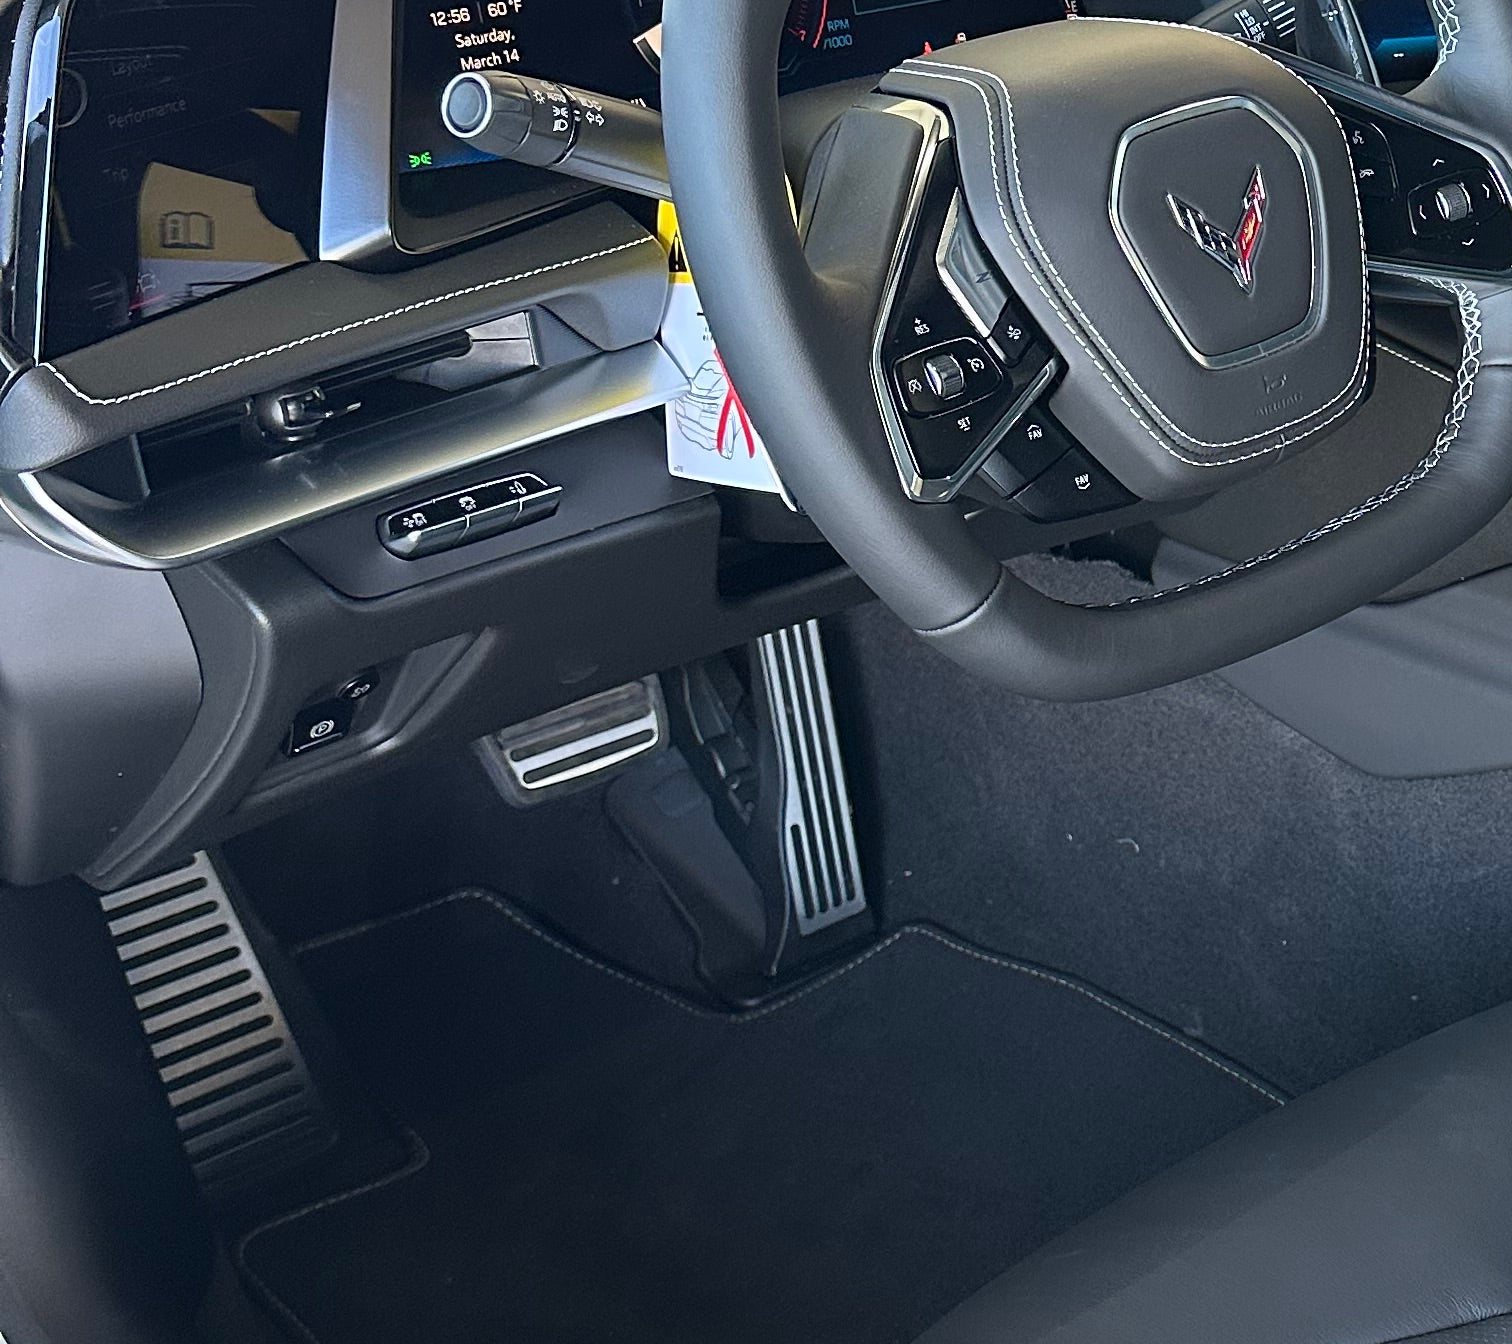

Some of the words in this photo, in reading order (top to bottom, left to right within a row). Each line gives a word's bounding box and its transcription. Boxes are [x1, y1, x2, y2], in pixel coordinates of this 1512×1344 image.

[1070, 0, 1079, 12] E
[430, 8, 471, 26] 12:56
[827, 18, 850, 32] RPM
[823, 34, 853, 50] /1000
[460, 53, 501, 71] March
[503, 49, 520, 64] 14
[108, 99, 187, 128] Performance
[914, 324, 930, 336] RES
[957, 416, 971, 429] SET
[1028, 428, 1043, 440] FAV
[1074, 473, 1090, 486] FAV
